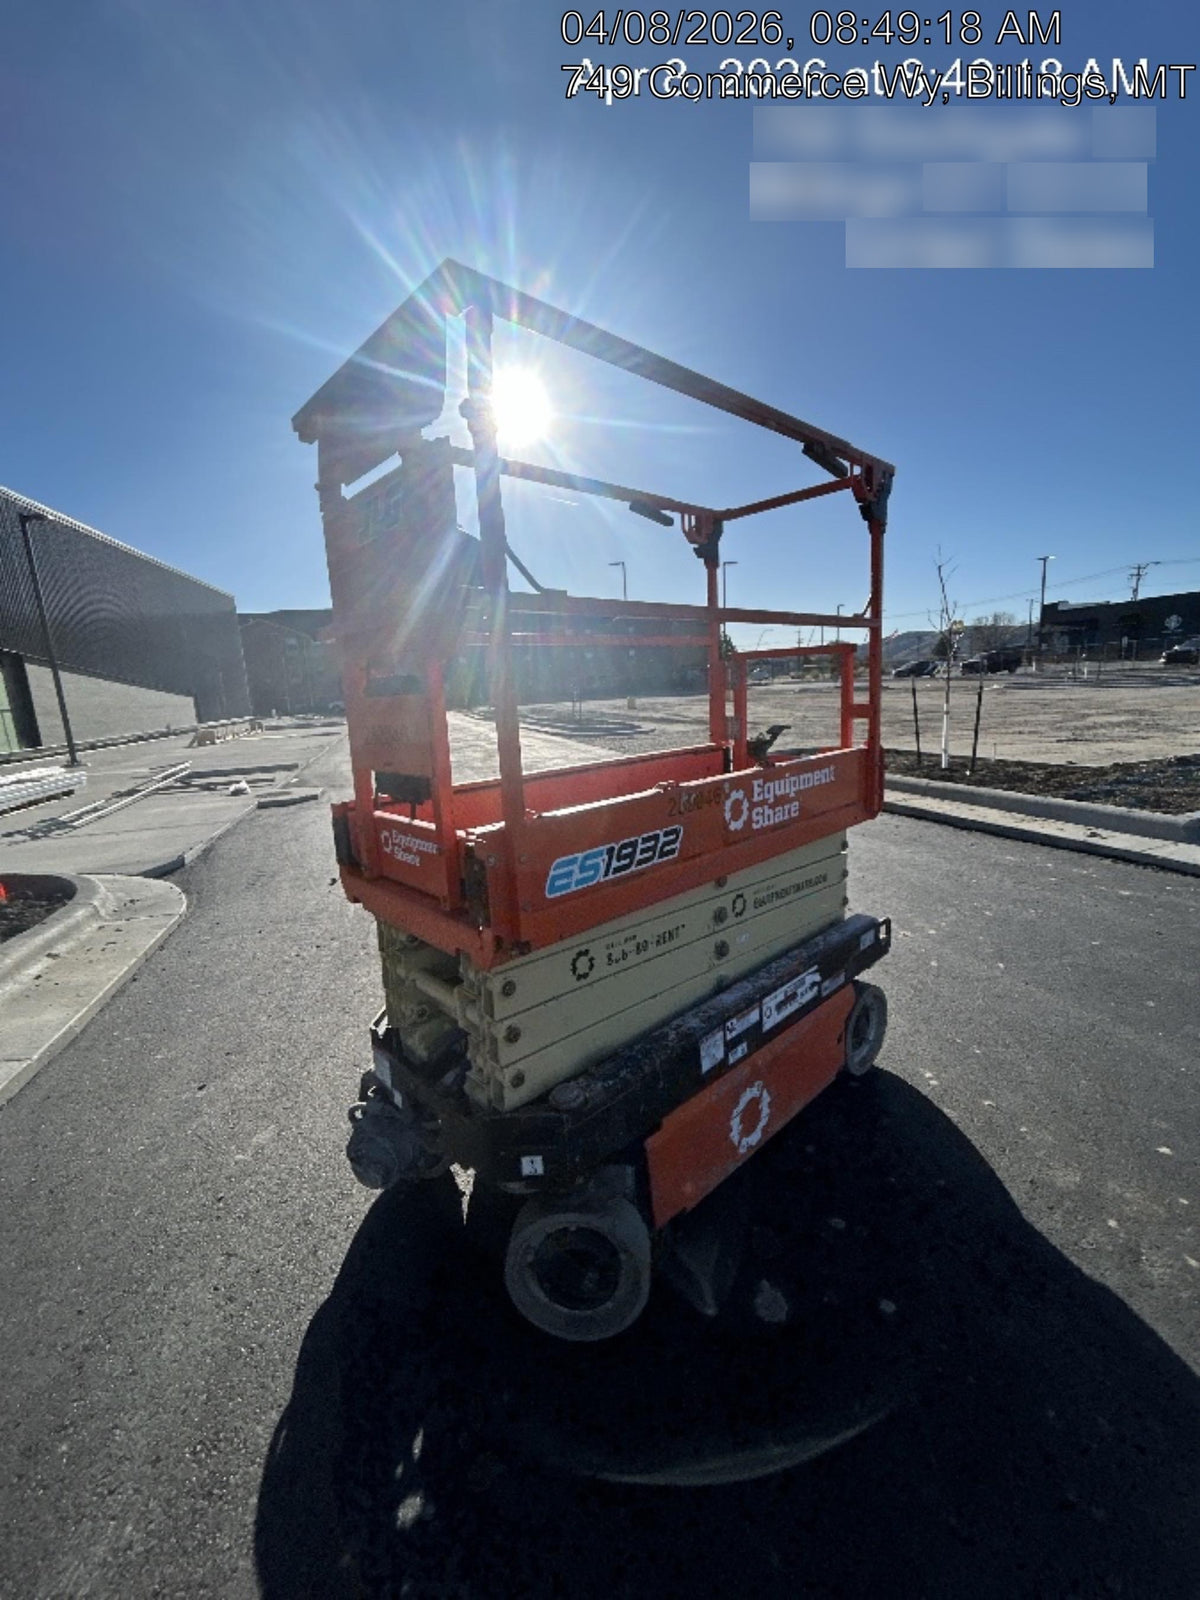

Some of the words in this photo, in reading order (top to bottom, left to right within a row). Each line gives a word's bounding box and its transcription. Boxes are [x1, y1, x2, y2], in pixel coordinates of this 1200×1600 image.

[752, 765, 836, 804] Equipment
[752, 801, 799, 830] Share
[545, 824, 684, 898] ES1932
